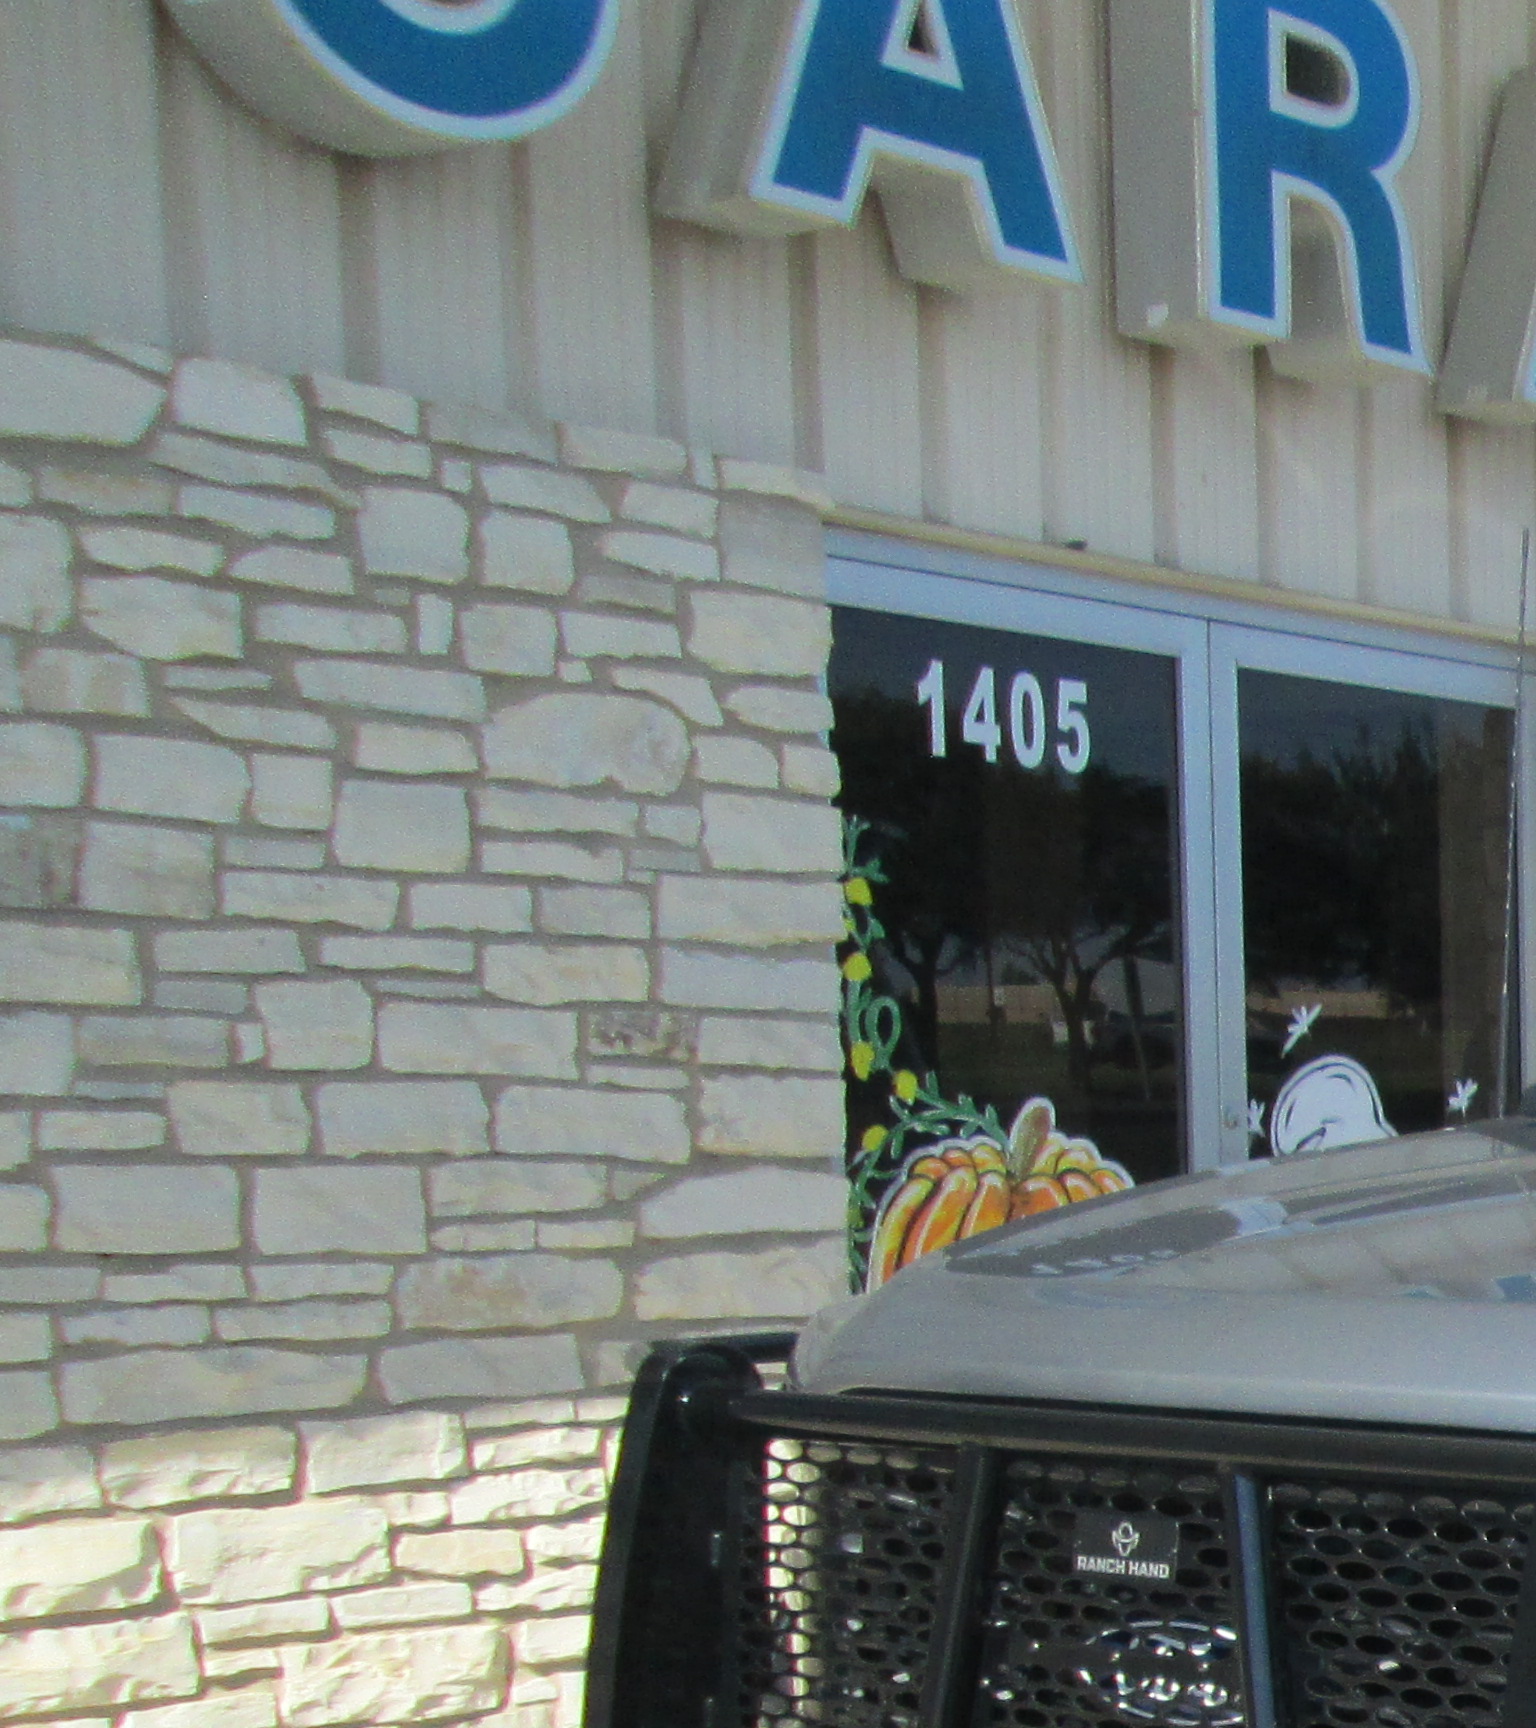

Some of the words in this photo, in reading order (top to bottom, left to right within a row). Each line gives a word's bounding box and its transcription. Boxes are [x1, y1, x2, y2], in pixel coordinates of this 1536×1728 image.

[917, 658, 1091, 774] 1405
[1077, 1555, 1125, 1575] RANCH
[1128, 1560, 1170, 1579] HAND
